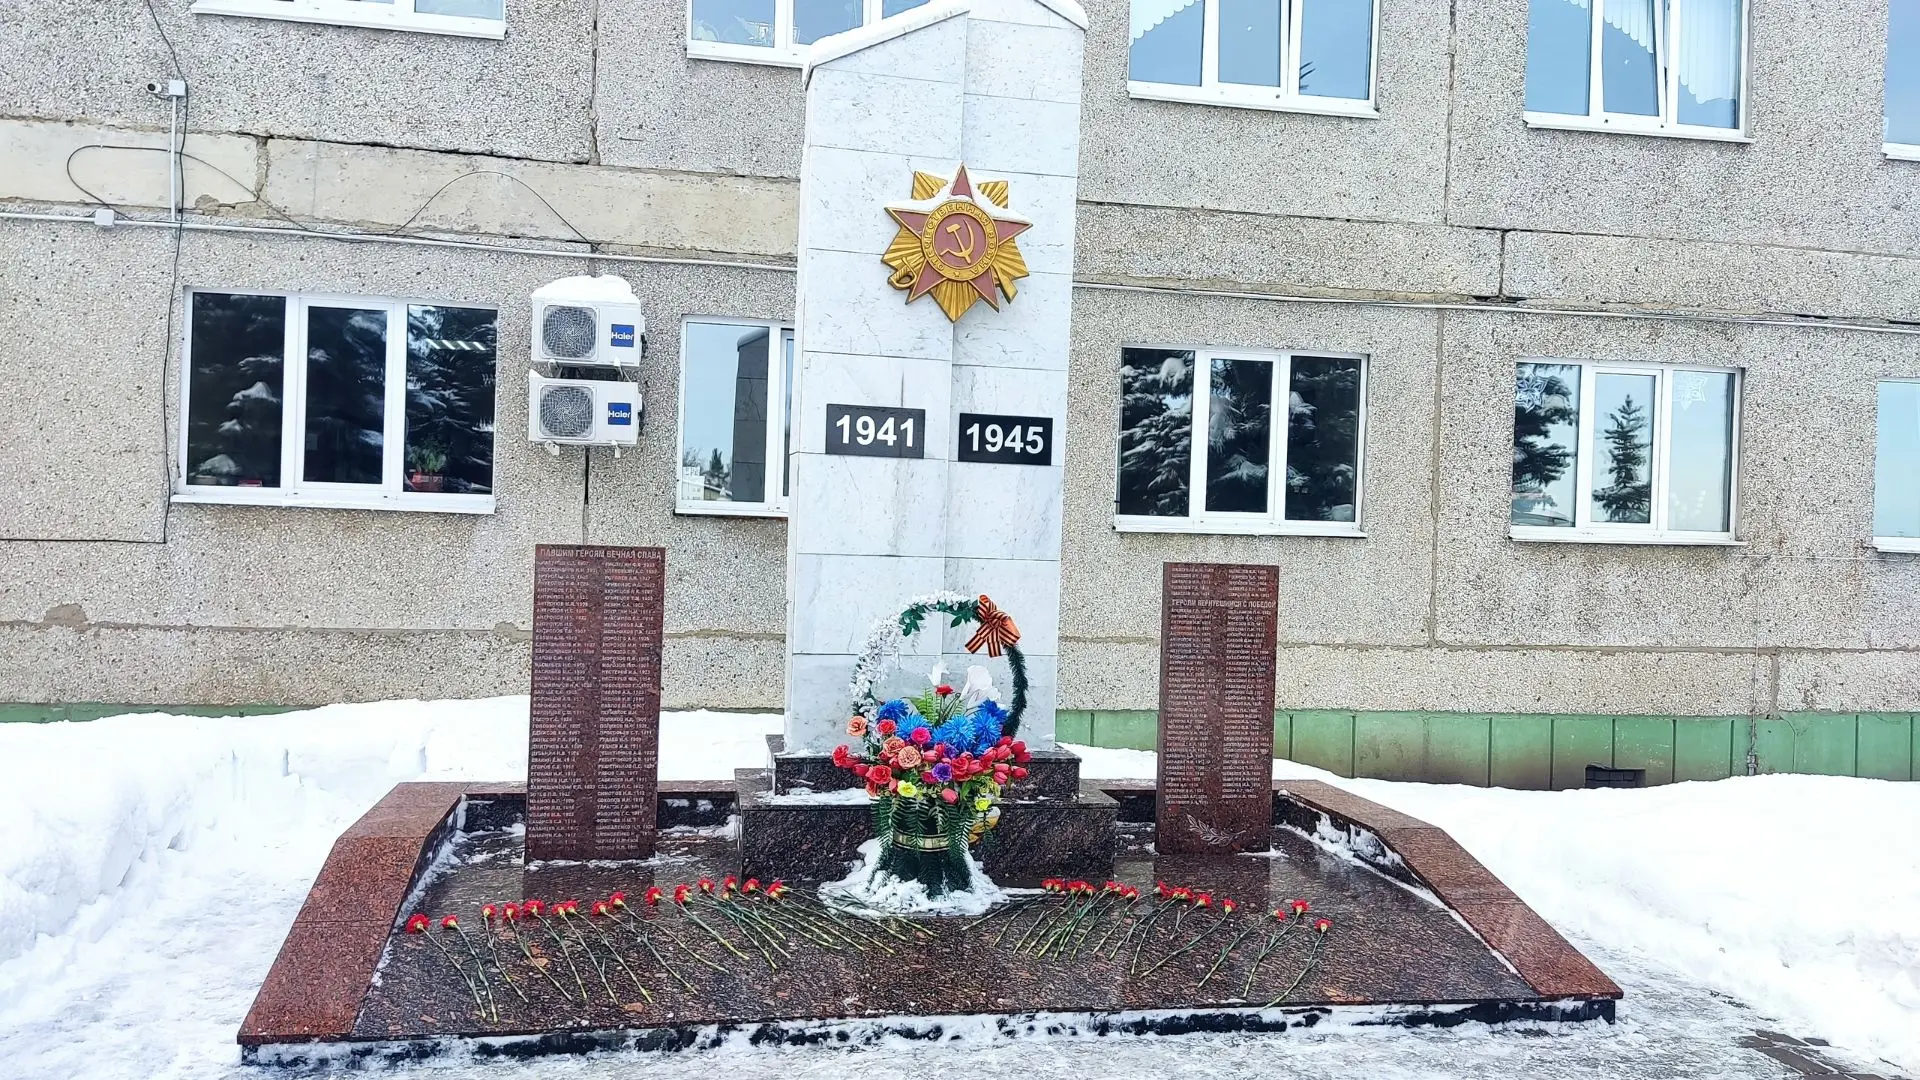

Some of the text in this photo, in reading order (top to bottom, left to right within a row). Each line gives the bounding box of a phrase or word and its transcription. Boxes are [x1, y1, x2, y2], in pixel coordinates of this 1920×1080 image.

[925, 202, 996, 275] ОТЕЧЕСТВЕННАЯ ВОЙНА
[611, 331, 634, 341] Haier
[608, 410, 631, 419] Haier
[835, 415, 914, 447] 1941
[966, 423, 1044, 453] 1945
[540, 549, 661, 560] ПАВШИМ ГЕРОЯМ ВЕЧНАЯ СЛАВА
